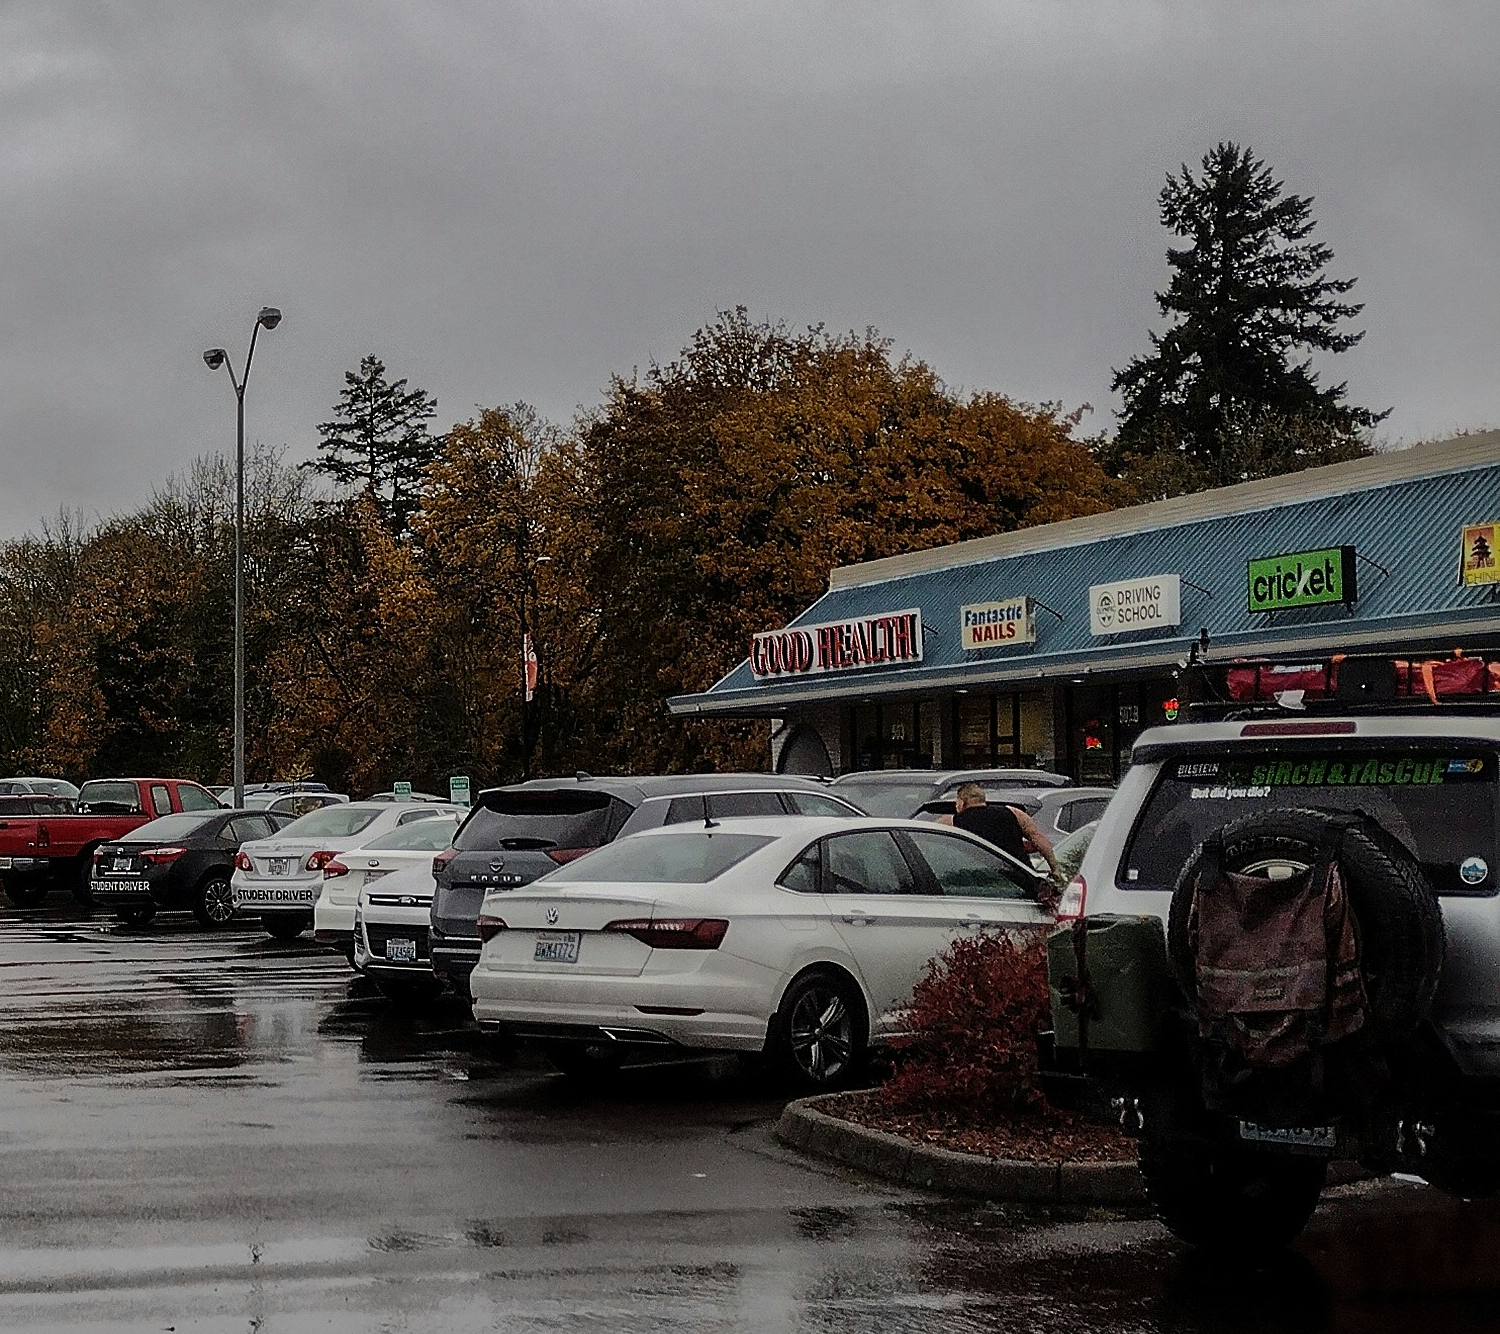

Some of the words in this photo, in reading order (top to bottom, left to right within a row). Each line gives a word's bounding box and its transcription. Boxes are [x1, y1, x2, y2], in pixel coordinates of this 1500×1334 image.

[1253, 558, 1336, 602] cricket
[1117, 585, 1161, 605] DRIVING
[964, 604, 1022, 627] Fantastic
[1118, 603, 1162, 623] SCHOOL
[972, 622, 1016, 643] NAILS
[750, 631, 814, 675] GOOD
[815, 613, 920, 668] HEALTH
[1177, 763, 1220, 775] BILSTEIN
[90, 881, 119, 892] STUDENT
[119, 880, 150, 891] DRIVER
[237, 890, 275, 901] STUDENT
[275, 889, 313, 902] DRIVER
